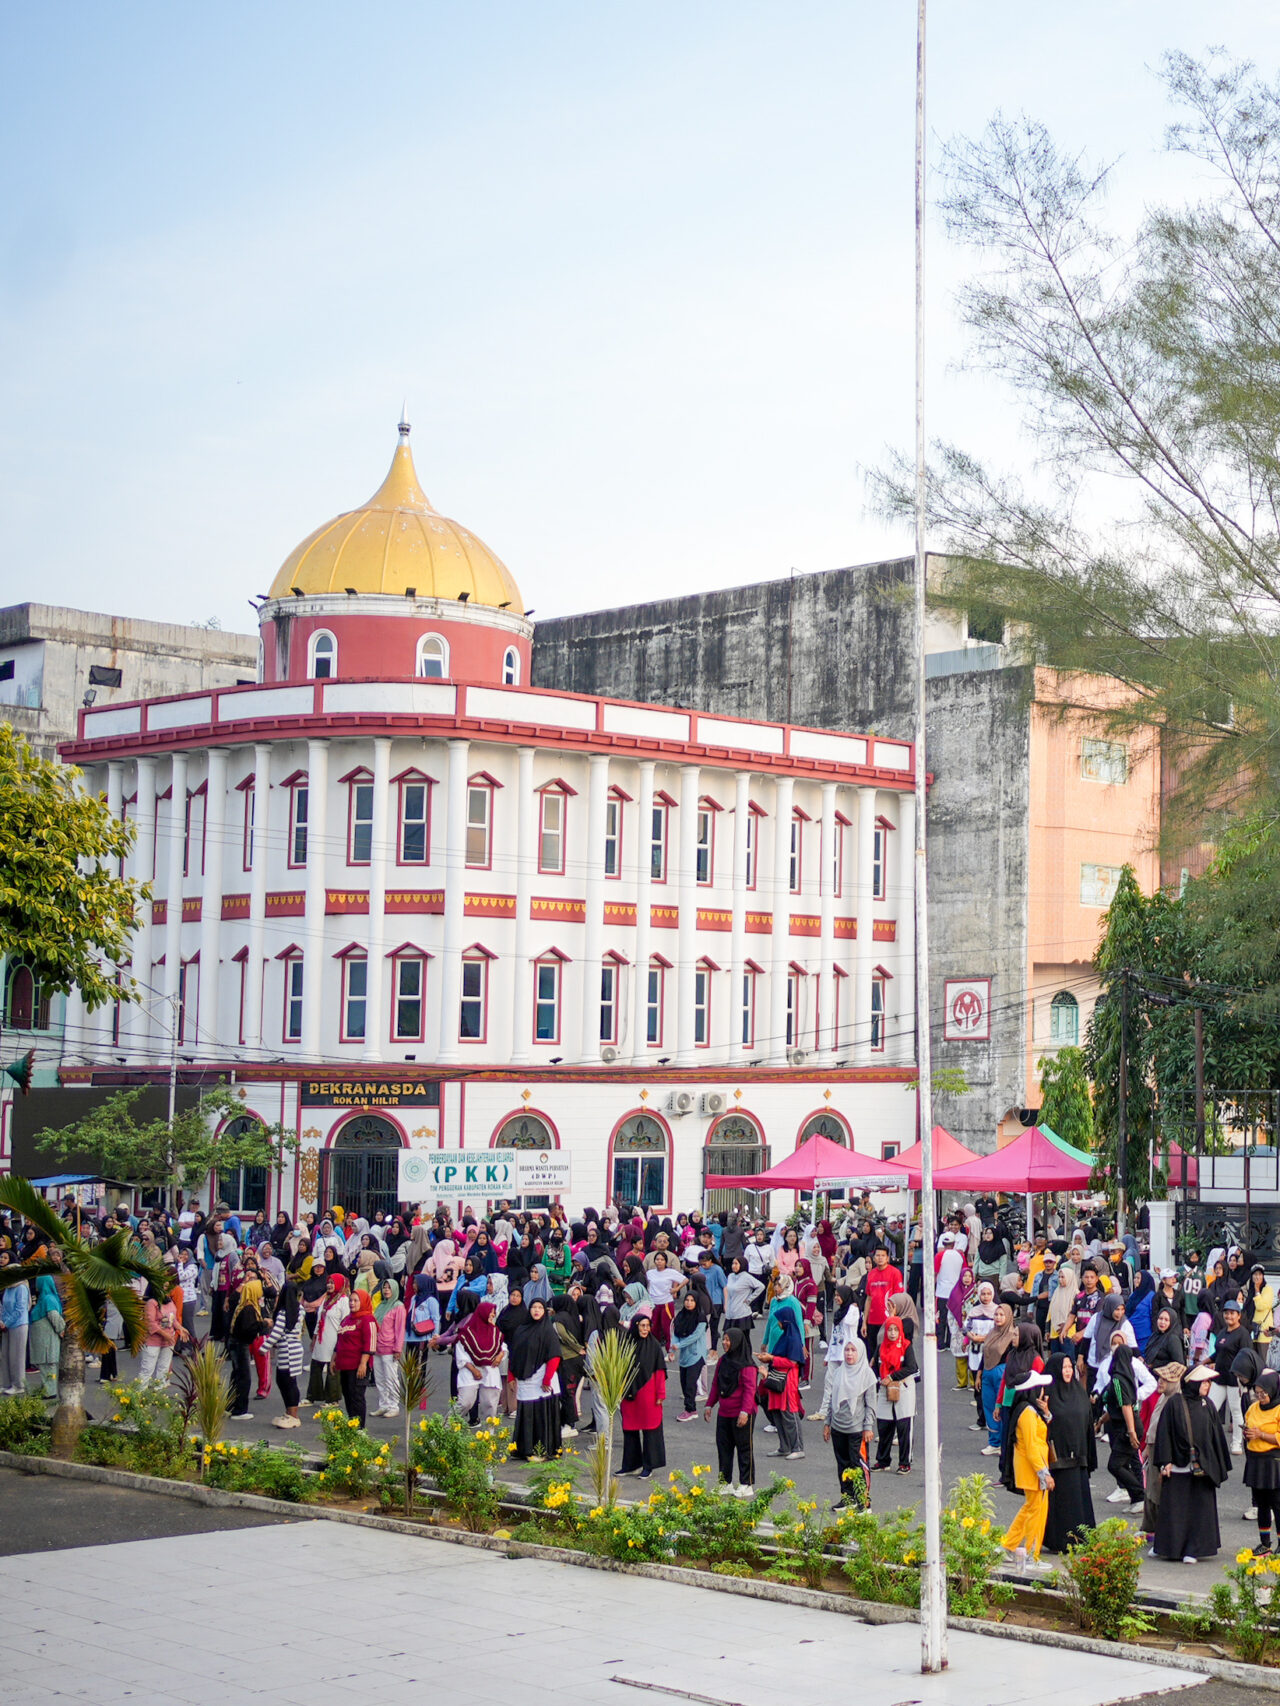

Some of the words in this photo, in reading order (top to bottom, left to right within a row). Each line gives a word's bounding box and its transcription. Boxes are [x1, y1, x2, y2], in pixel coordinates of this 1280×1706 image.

[309, 1082, 427, 1095] DEKRANASDA
[333, 1096, 368, 1105] ROKAN
[372, 1097, 399, 1105] HILIR
[1183, 1278, 1202, 1295] 09
